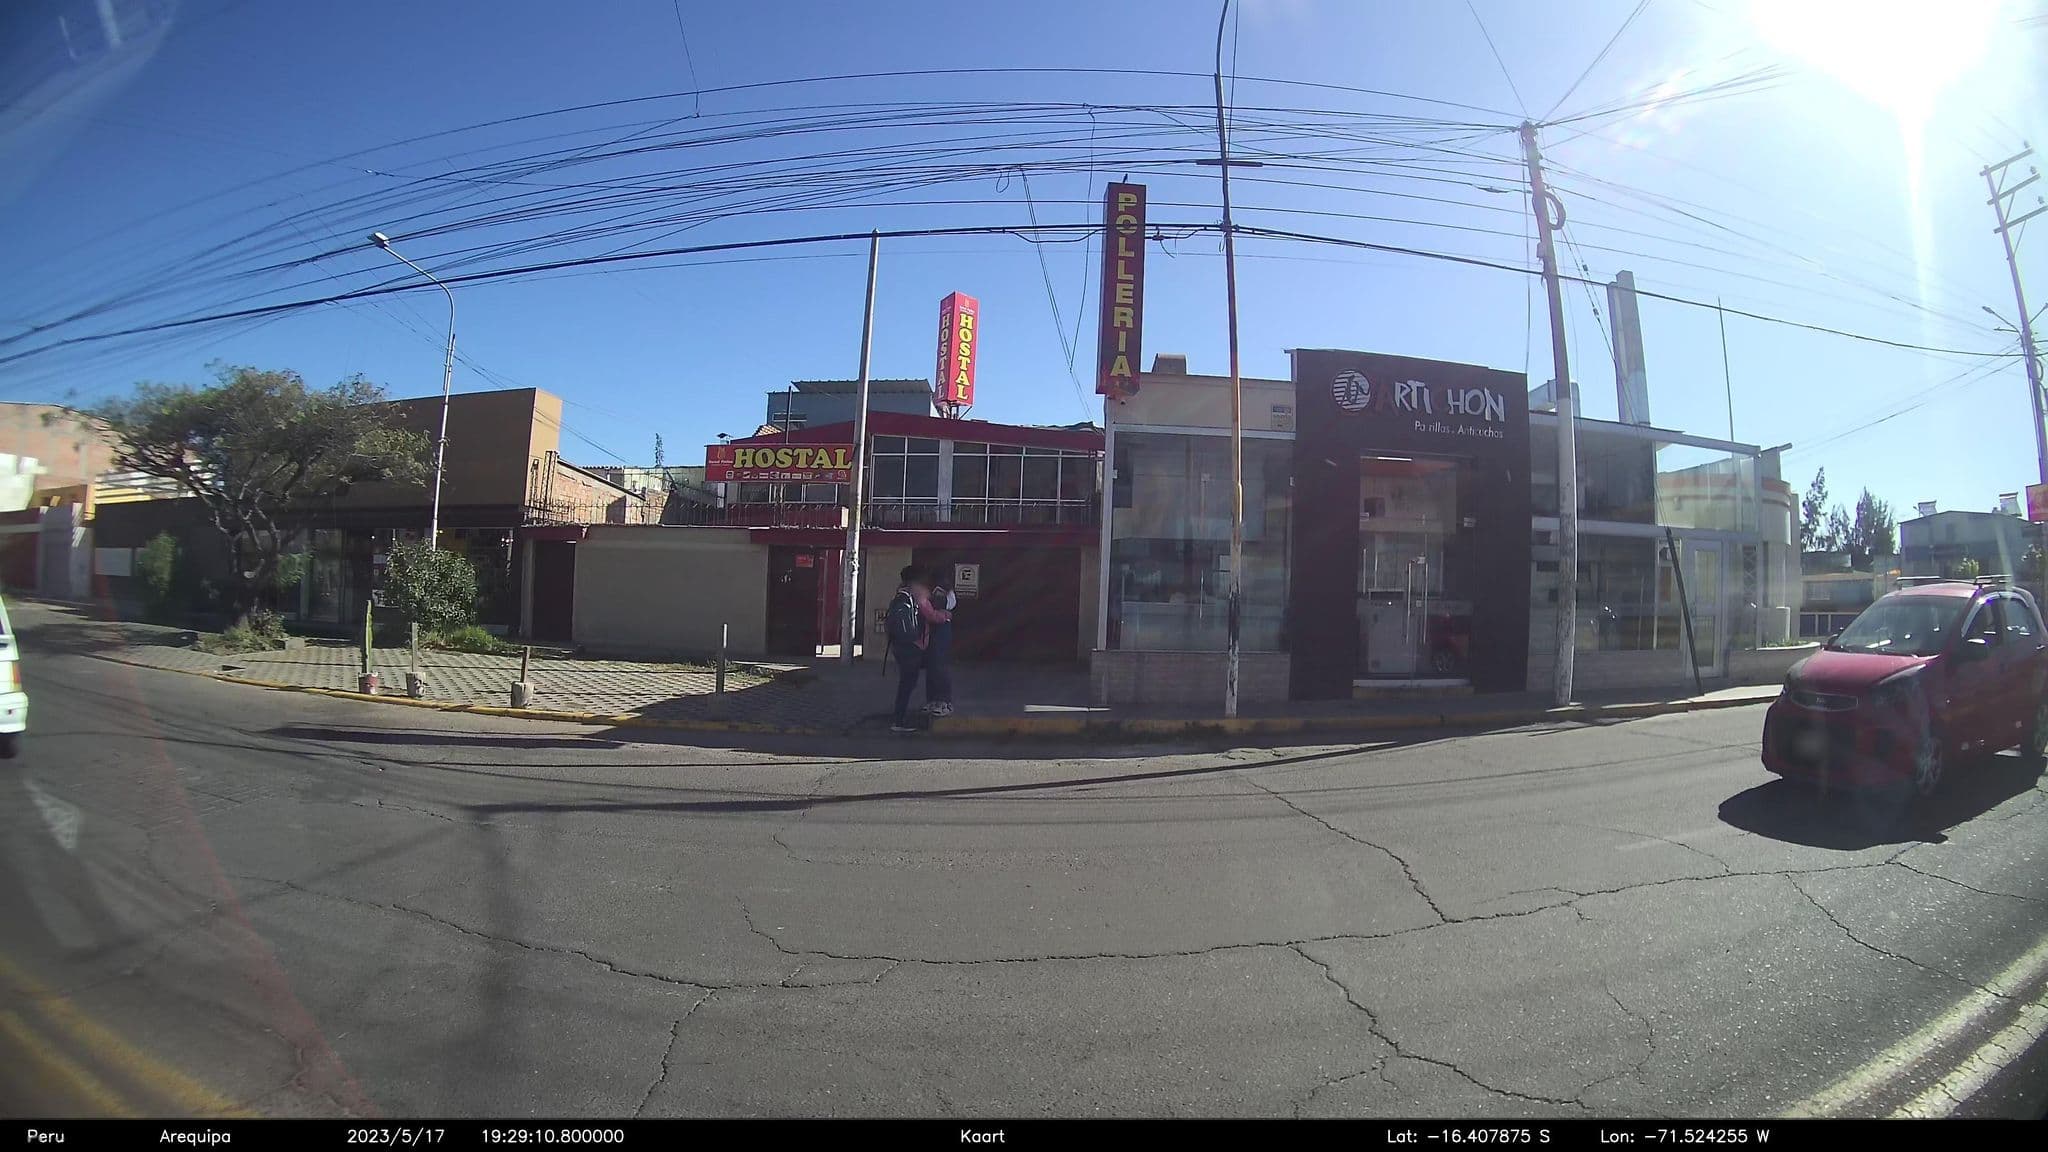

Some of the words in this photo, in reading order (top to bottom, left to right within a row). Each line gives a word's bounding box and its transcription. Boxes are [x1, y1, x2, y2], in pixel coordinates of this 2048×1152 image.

[1110, 192, 1138, 378] POLLERIA
[937, 313, 951, 399] HOSTAL
[955, 313, 974, 400] HOSTAL
[733, 447, 852, 469] HOSTAL
